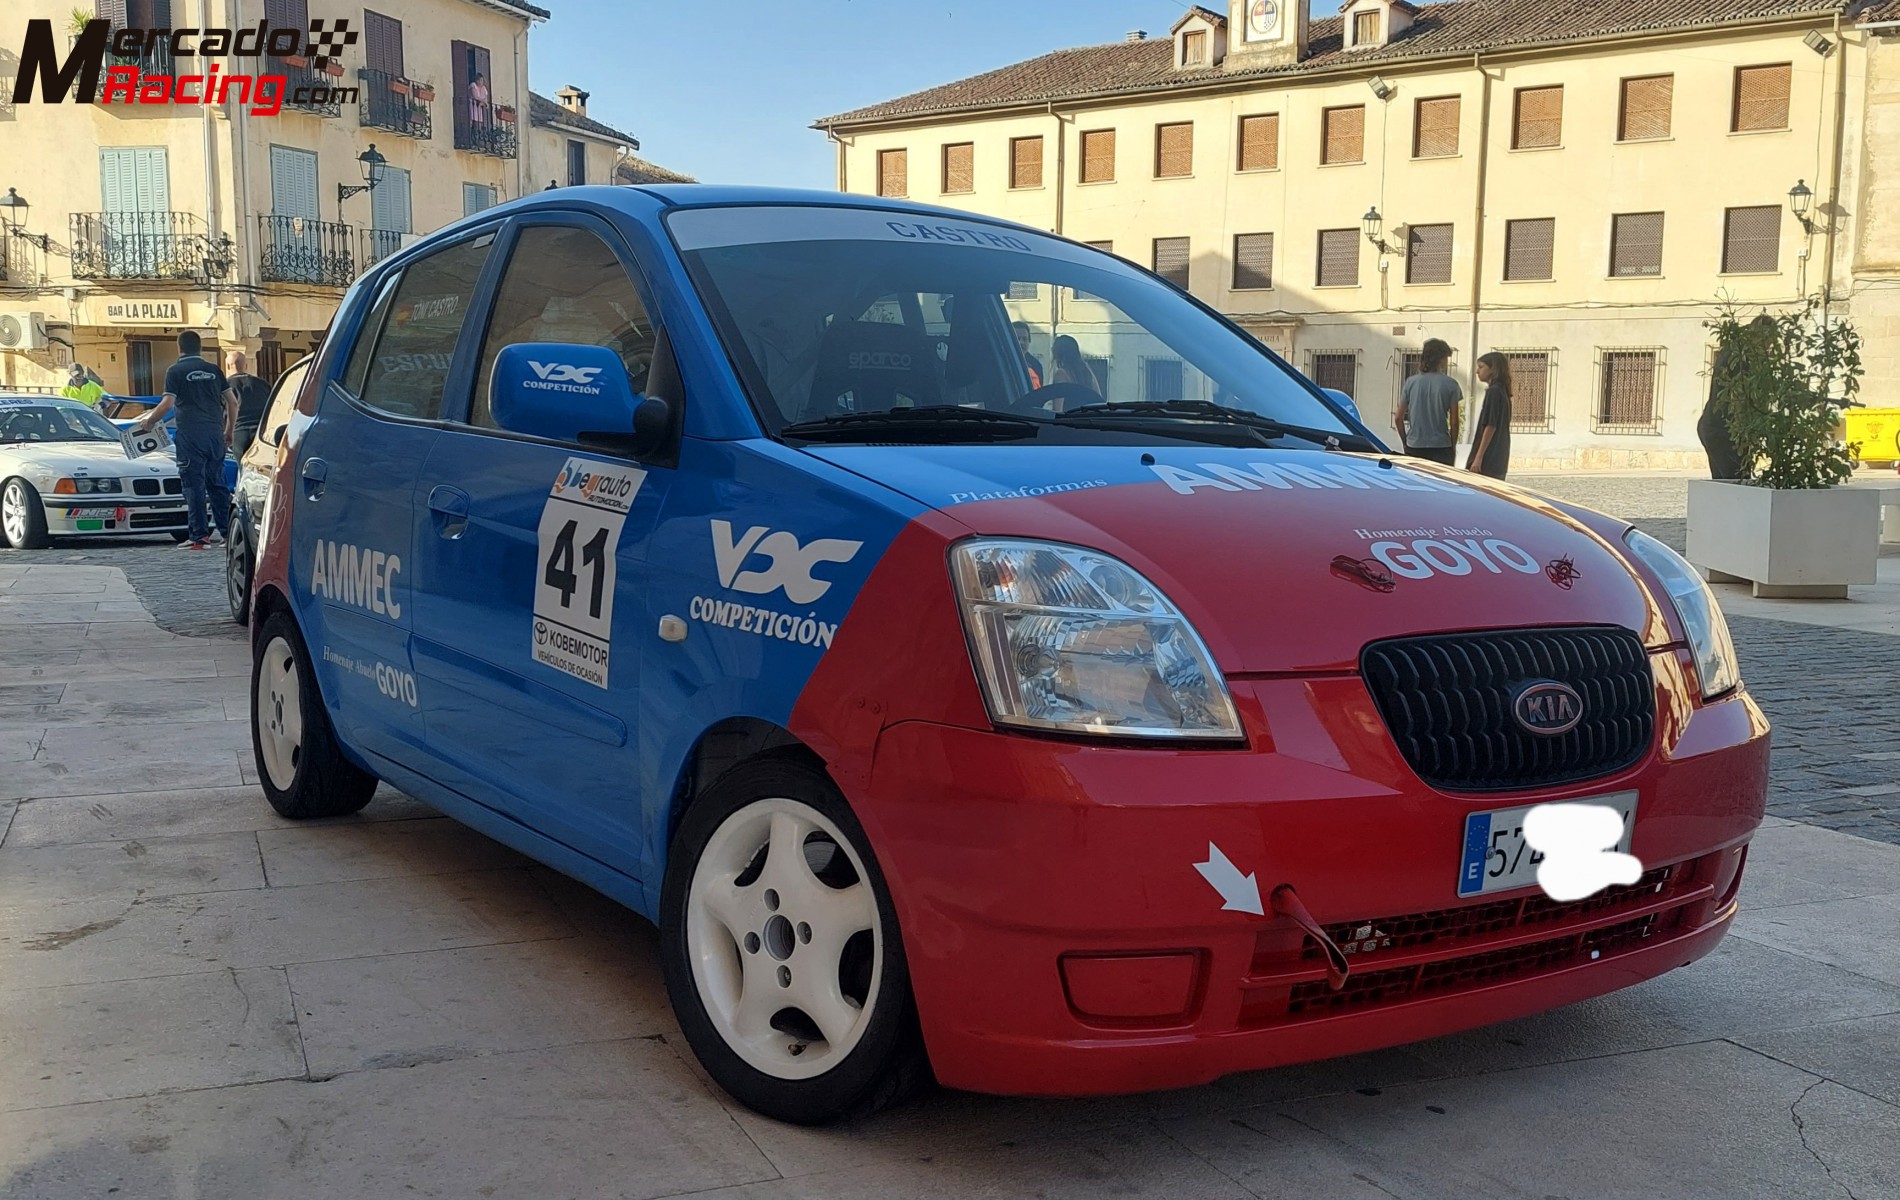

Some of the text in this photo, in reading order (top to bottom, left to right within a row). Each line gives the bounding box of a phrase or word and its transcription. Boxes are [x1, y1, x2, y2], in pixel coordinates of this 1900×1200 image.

[886, 222, 1032, 251] CASTRO
[108, 304, 178, 319] BAR LA PLAZA
[848, 351, 912, 370] sparco
[523, 380, 601, 395] COMPETICIÓN
[949, 478, 1108, 504] Plataformas
[1353, 526, 1494, 540] Homenaje Abuelo
[544, 519, 610, 620] 41
[1370, 539, 1541, 580] GOYO
[311, 539, 401, 620] AMMEC
[689, 595, 838, 651] COMPETICIÓN
[549, 629, 608, 668] KOBEMOTOR
[323, 645, 418, 708] Homenaje Abuelo GOYO
[537, 649, 603, 685] VEHÍCULOS DE OCASIÓN
[1525, 694, 1575, 723] KIA
[1468, 862, 1480, 880] E
